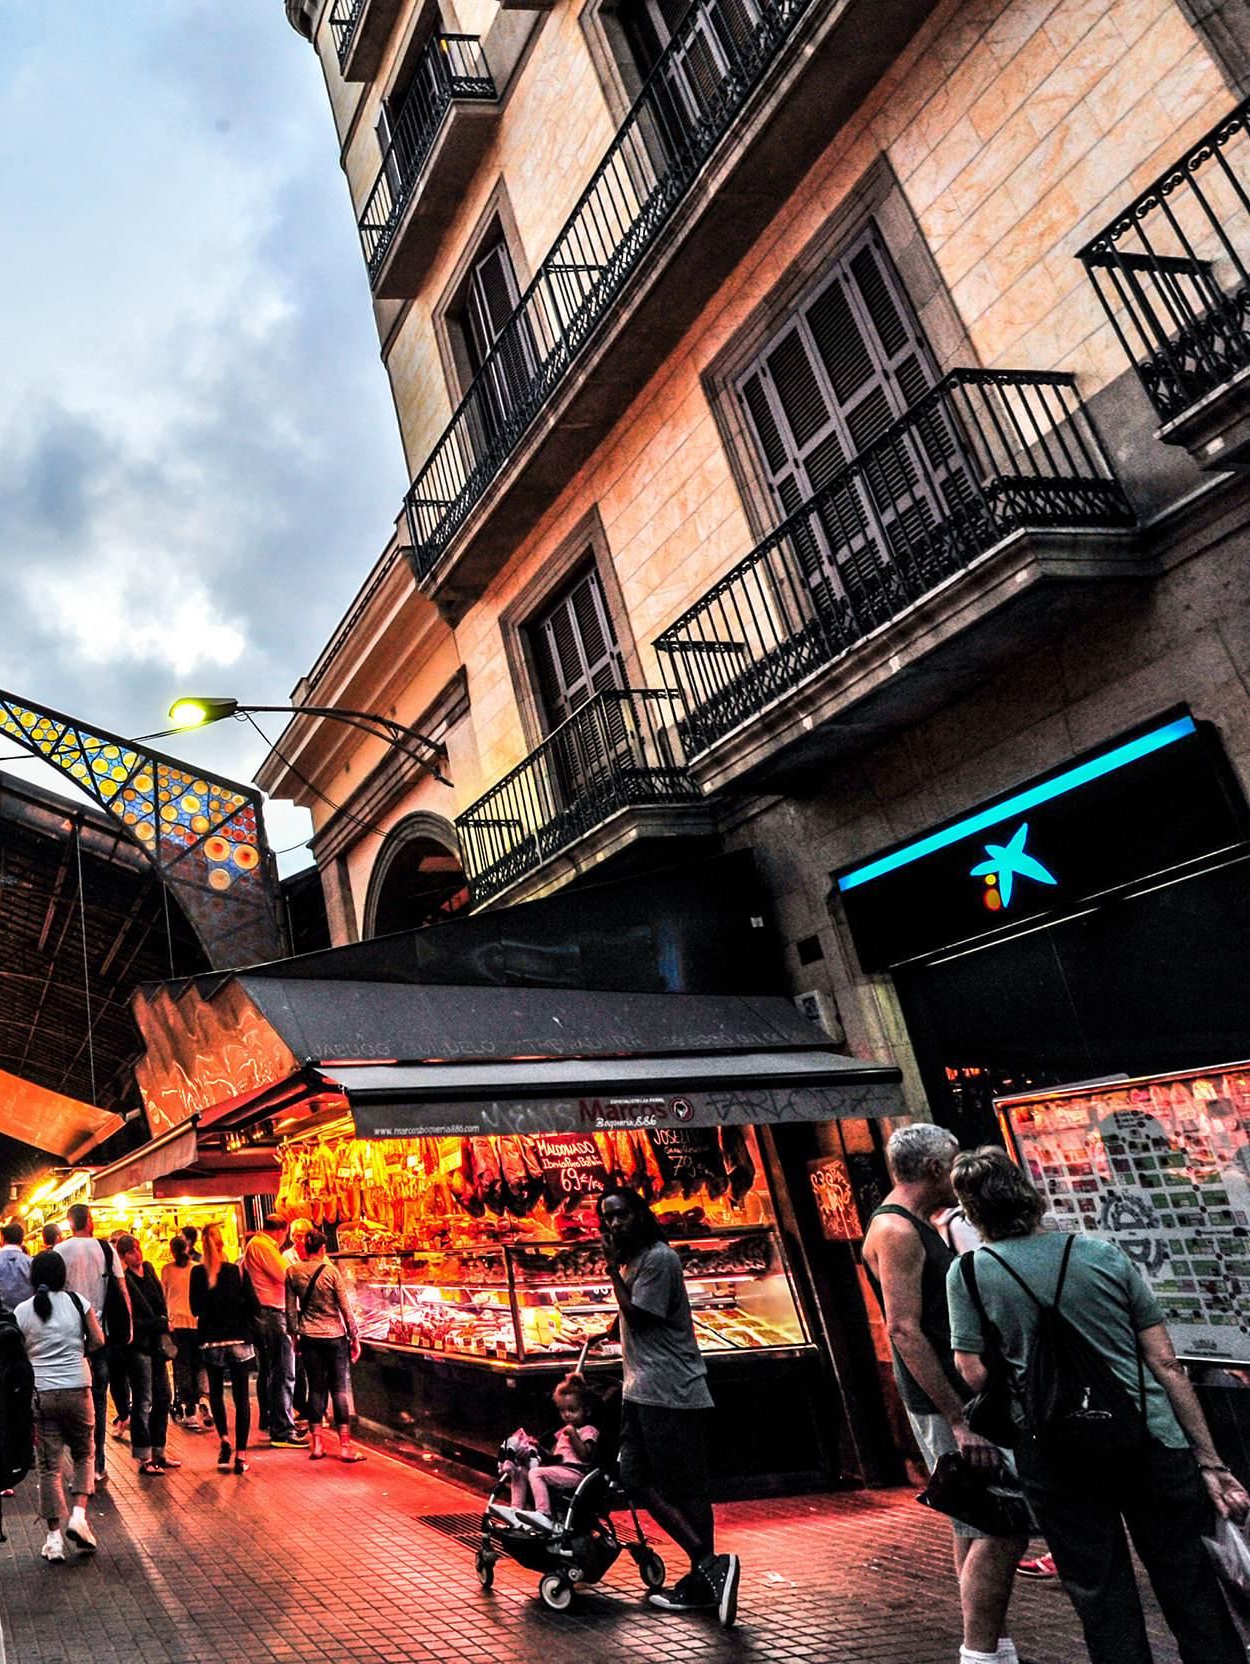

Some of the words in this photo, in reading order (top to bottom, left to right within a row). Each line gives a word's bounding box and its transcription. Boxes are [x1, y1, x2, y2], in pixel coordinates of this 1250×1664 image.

[579, 1099, 669, 1122] Marcos
[373, 1124, 480, 1136] www.marcosboqueria886.com
[536, 1139, 595, 1157] MALDONADO
